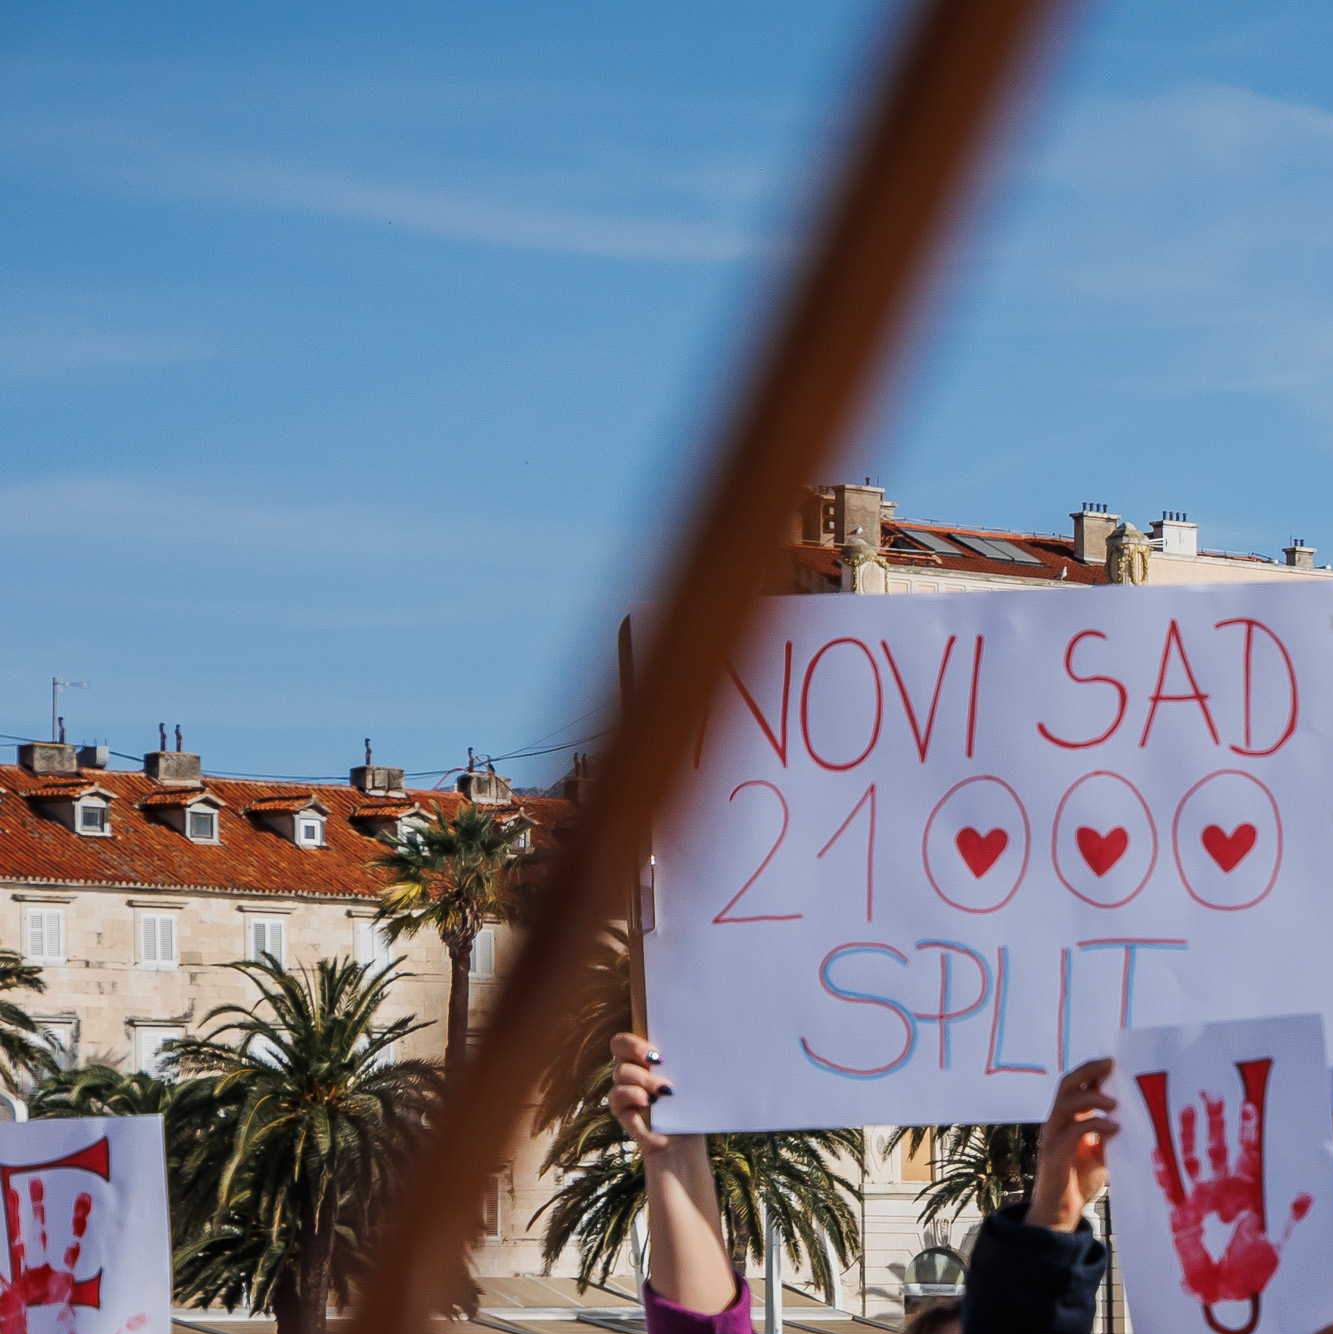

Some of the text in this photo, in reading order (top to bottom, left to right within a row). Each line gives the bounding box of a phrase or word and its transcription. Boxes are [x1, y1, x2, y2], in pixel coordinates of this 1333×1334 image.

[692, 617, 1298, 771] NOVI SAD
[800, 939, 1189, 1080] SPLIT
